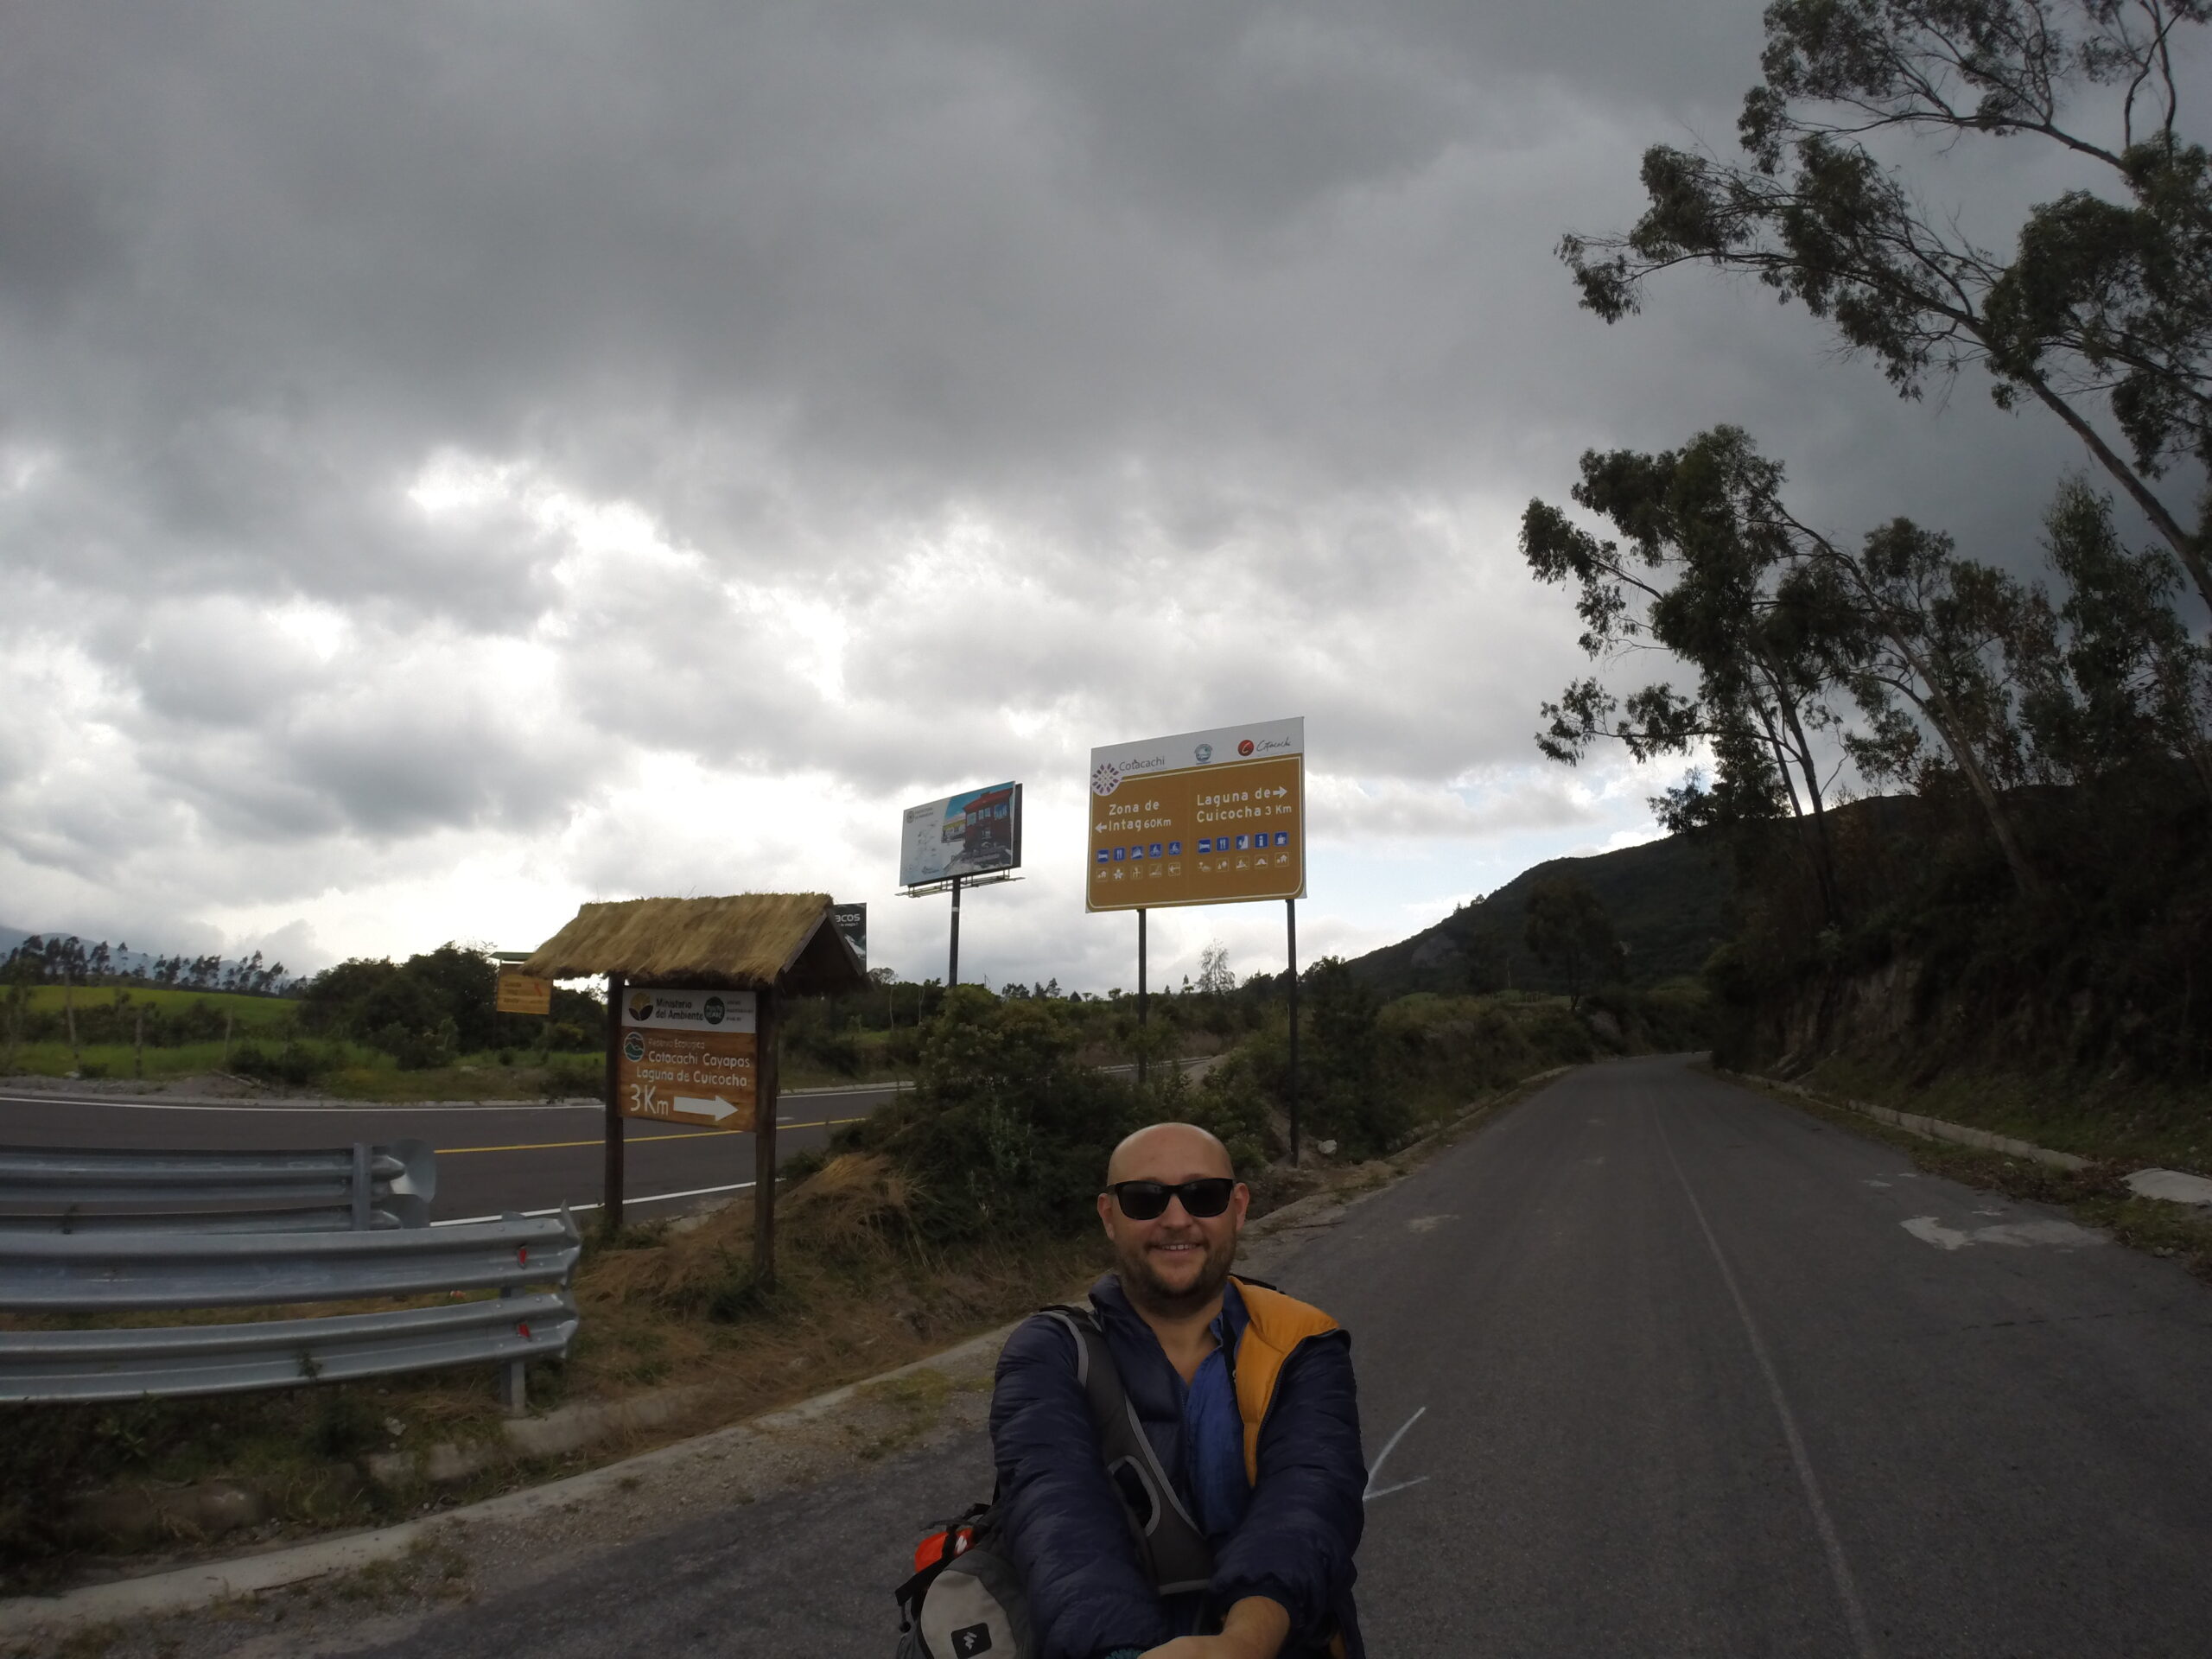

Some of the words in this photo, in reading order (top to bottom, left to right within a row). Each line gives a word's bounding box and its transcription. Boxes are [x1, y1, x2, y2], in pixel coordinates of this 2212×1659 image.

[1119, 755, 1165, 772] Cotacachi
[1197, 792, 1248, 808] Laguna
[1255, 787, 1271, 799] de
[1109, 804, 1139, 816] Zona
[1145, 800, 1160, 810] de
[1197, 806, 1262, 823] Cuicocha
[1265, 806, 1271, 816] 3
[1275, 805, 1292, 814] Km
[1109, 819, 1141, 831] Intag
[656, 998, 692, 1008] Ministerio
[656, 1009, 667, 1019] del
[668, 1011, 703, 1020] Ambiente
[648, 1051, 697, 1065] Cotacachi
[702, 1053, 750, 1068] Cayapas
[637, 1066, 673, 1082] Laguna
[677, 1070, 690, 1081] de
[693, 1071, 747, 1087] Cuicocha
